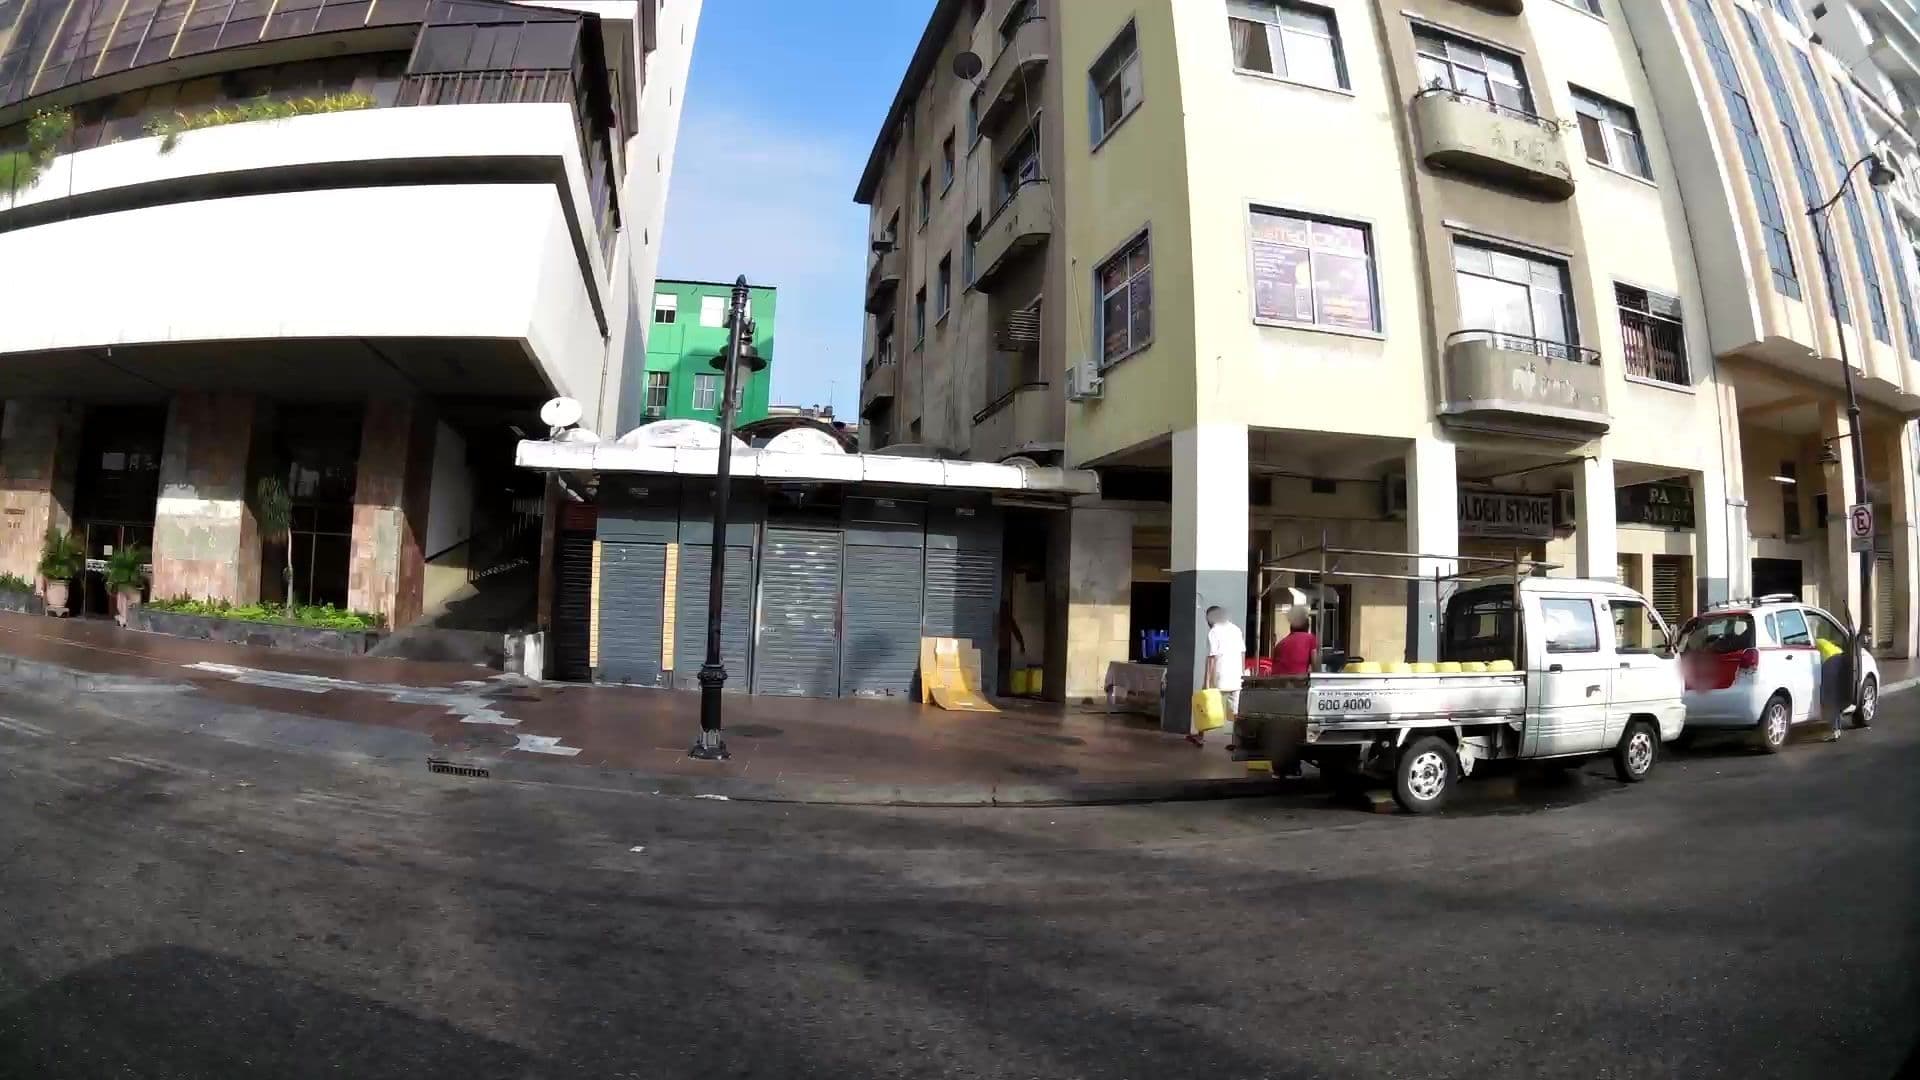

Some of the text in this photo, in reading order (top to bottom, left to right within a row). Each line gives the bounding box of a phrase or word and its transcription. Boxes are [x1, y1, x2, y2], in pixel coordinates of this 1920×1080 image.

[1506, 499, 1550, 525] STORE
[1318, 698, 1372, 711] 600 4000
